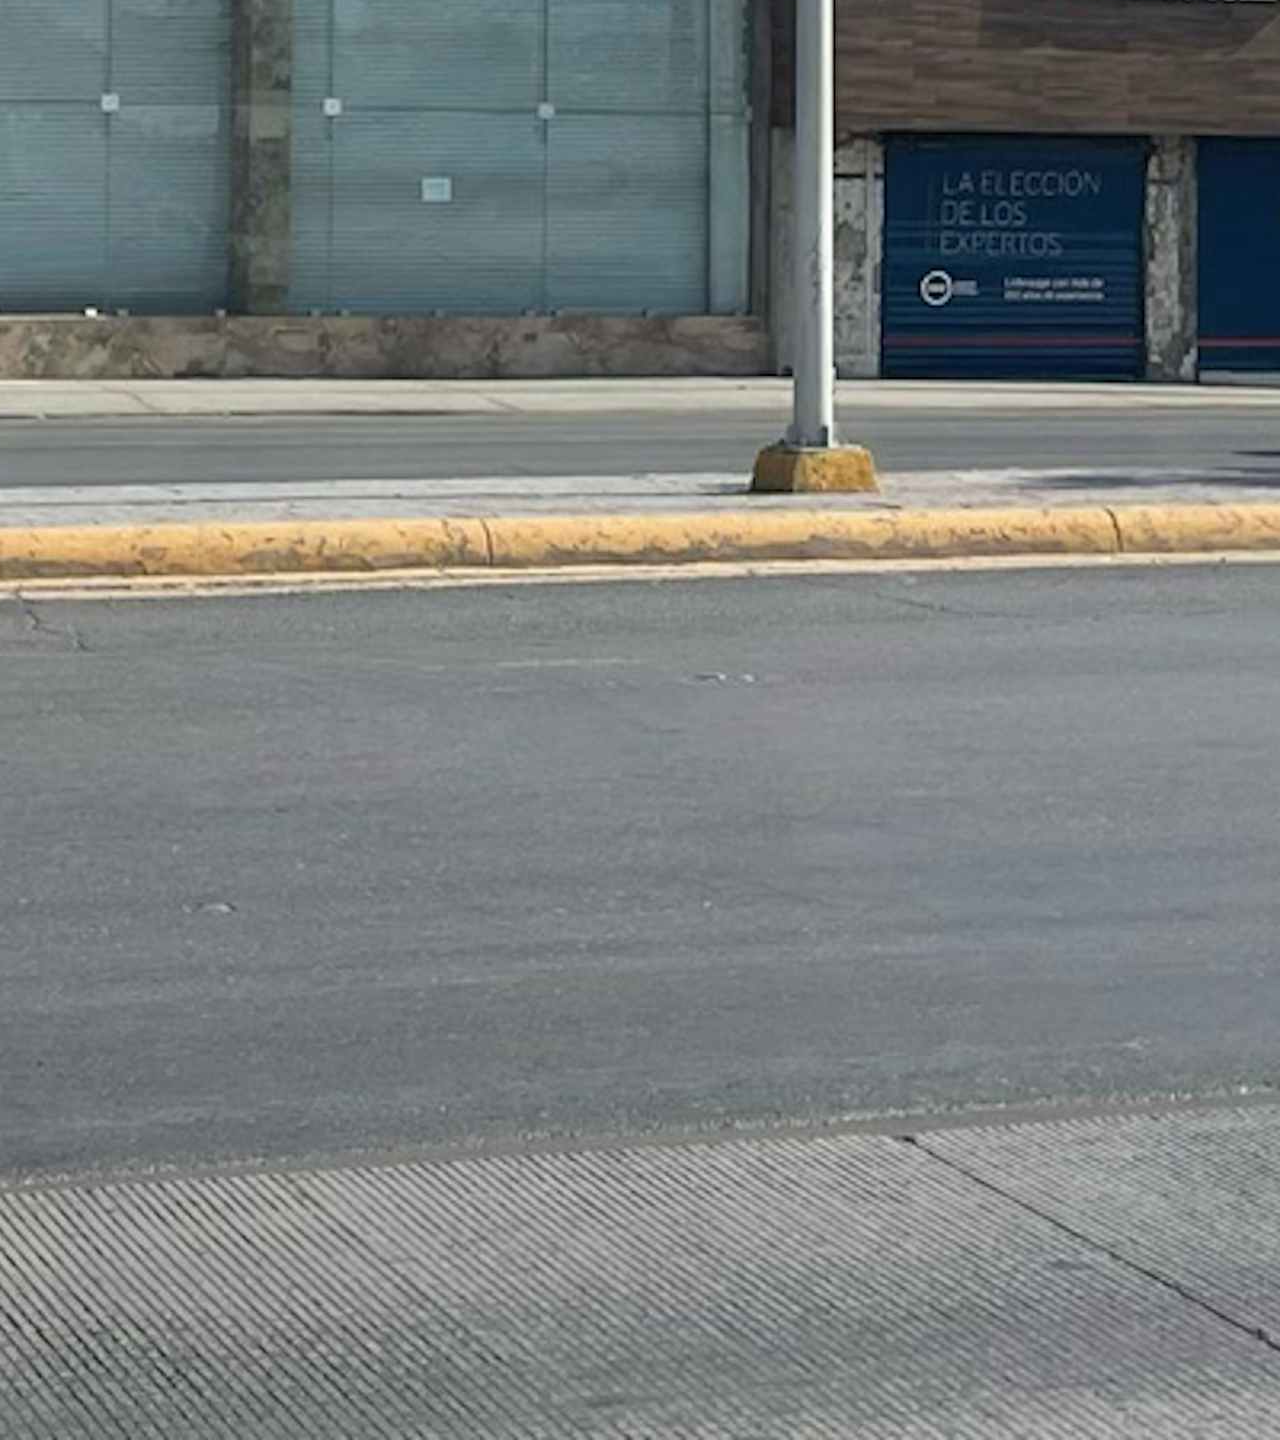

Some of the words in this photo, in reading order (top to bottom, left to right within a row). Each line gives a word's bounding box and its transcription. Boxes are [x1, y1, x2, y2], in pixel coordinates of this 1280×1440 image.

[942, 170, 975, 196] LA
[940, 199, 976, 227] DE
[980, 199, 1028, 228] LOS
[939, 229, 1063, 257] EXPERTOS
